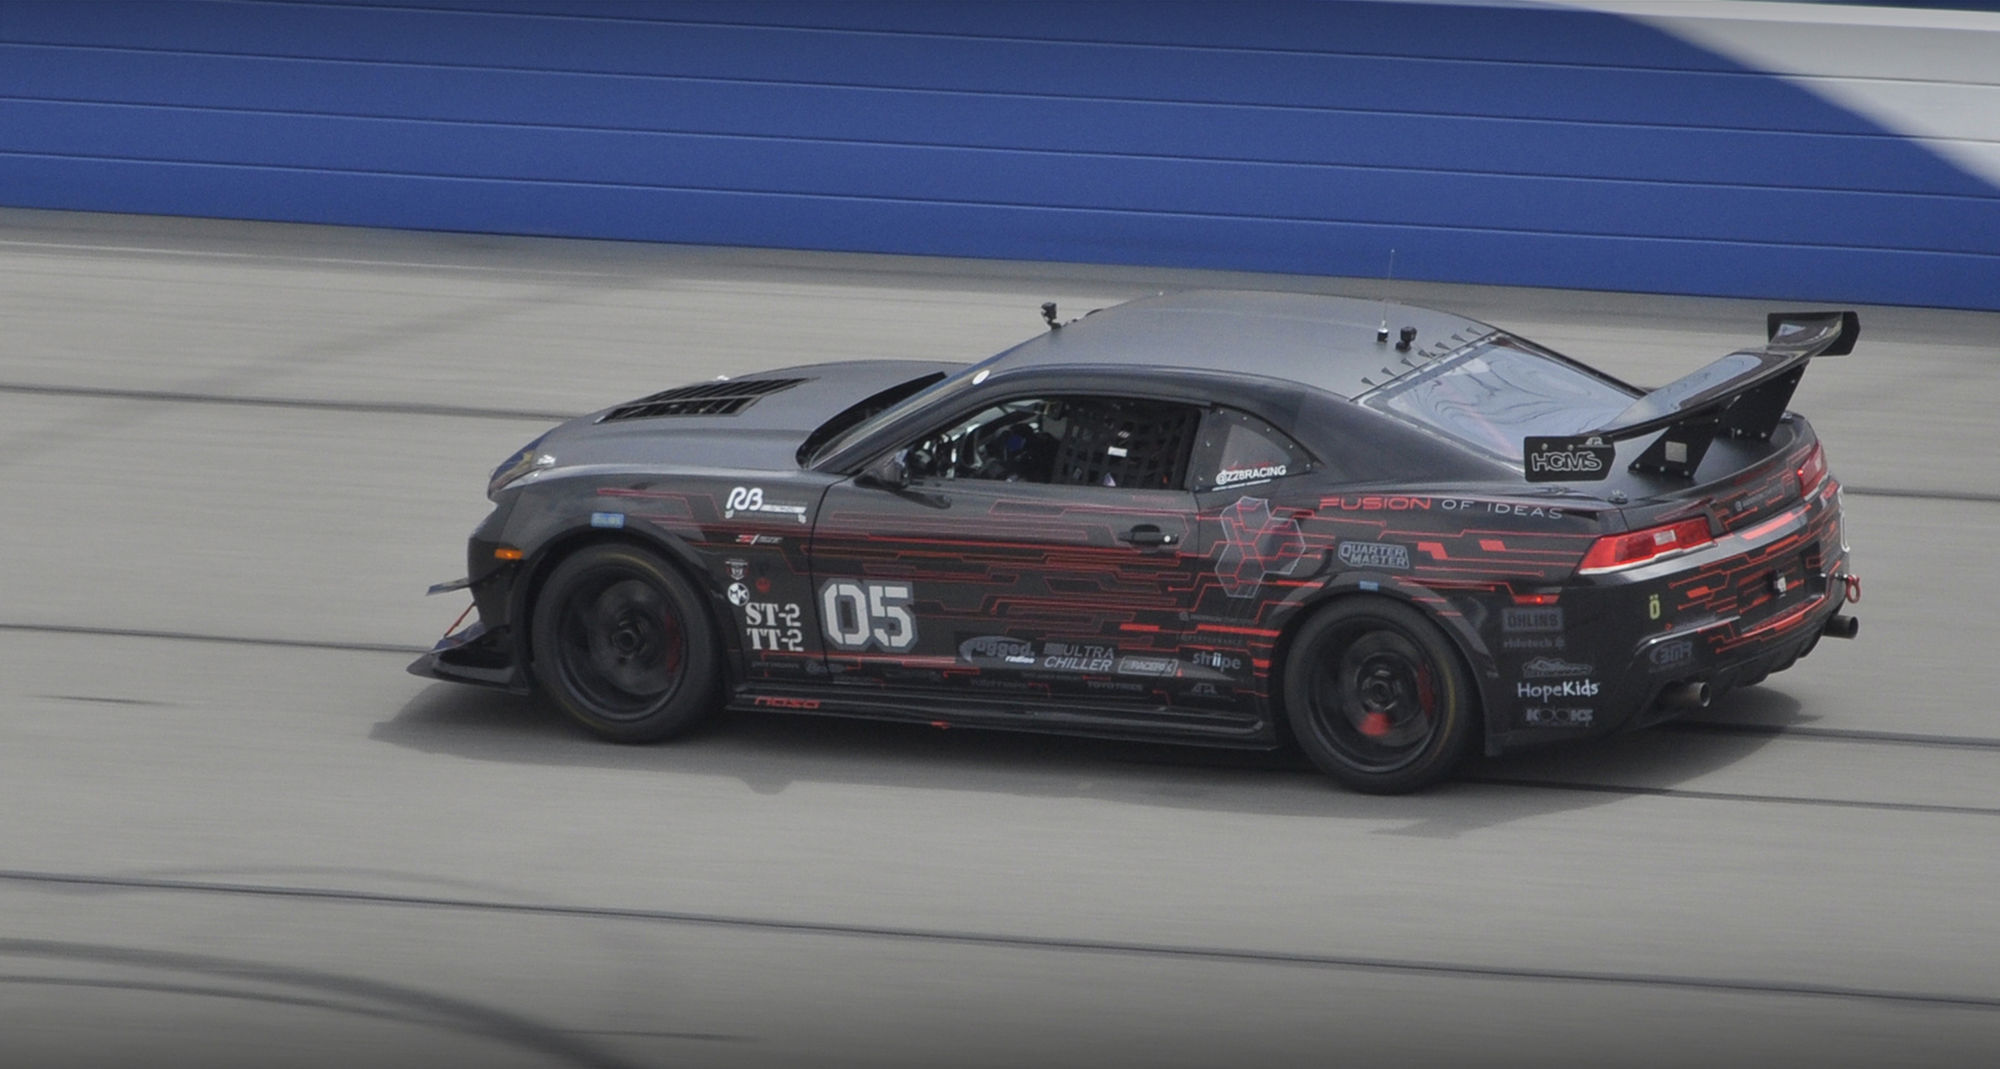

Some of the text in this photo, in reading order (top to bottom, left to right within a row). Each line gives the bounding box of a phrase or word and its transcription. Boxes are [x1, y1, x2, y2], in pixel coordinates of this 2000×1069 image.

[1319, 495, 1563, 519] FUSION OF IDEAS
[1341, 541, 1406, 558] QUARTER
[1350, 554, 1408, 568] MASTER
[745, 602, 801, 627] ST-2
[821, 580, 916, 649] 05
[746, 628, 804, 651] TT-2
[1063, 643, 1114, 659] ULTRA
[1044, 656, 1113, 672] CHILLER
[1517, 679, 1599, 702] HopeKids
